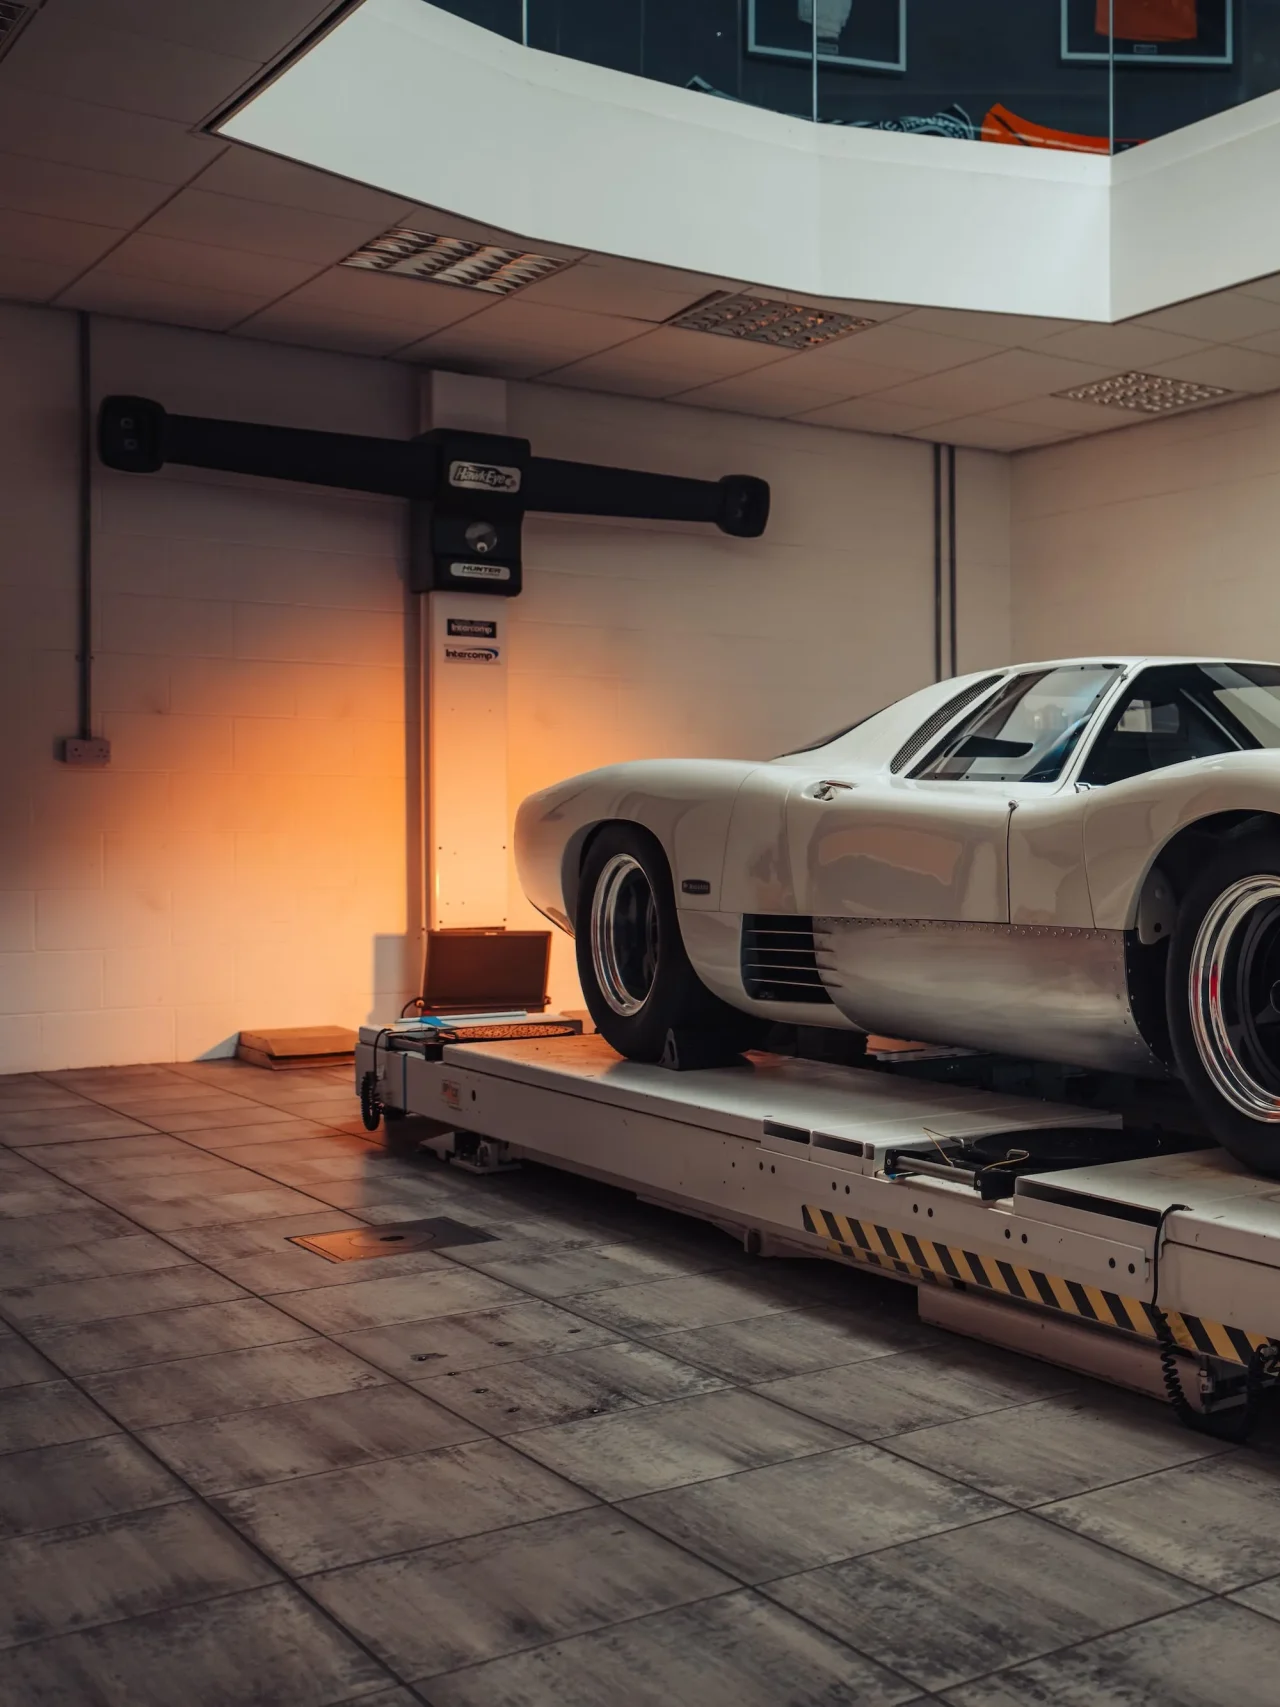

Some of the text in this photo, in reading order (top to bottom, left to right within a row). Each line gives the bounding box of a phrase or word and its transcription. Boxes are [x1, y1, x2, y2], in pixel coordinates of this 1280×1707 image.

[455, 466, 506, 486] HawkEye
[462, 565, 501, 574] HUNTER
[451, 623, 493, 635] Intercomp
[445, 648, 493, 661] Intercomp
